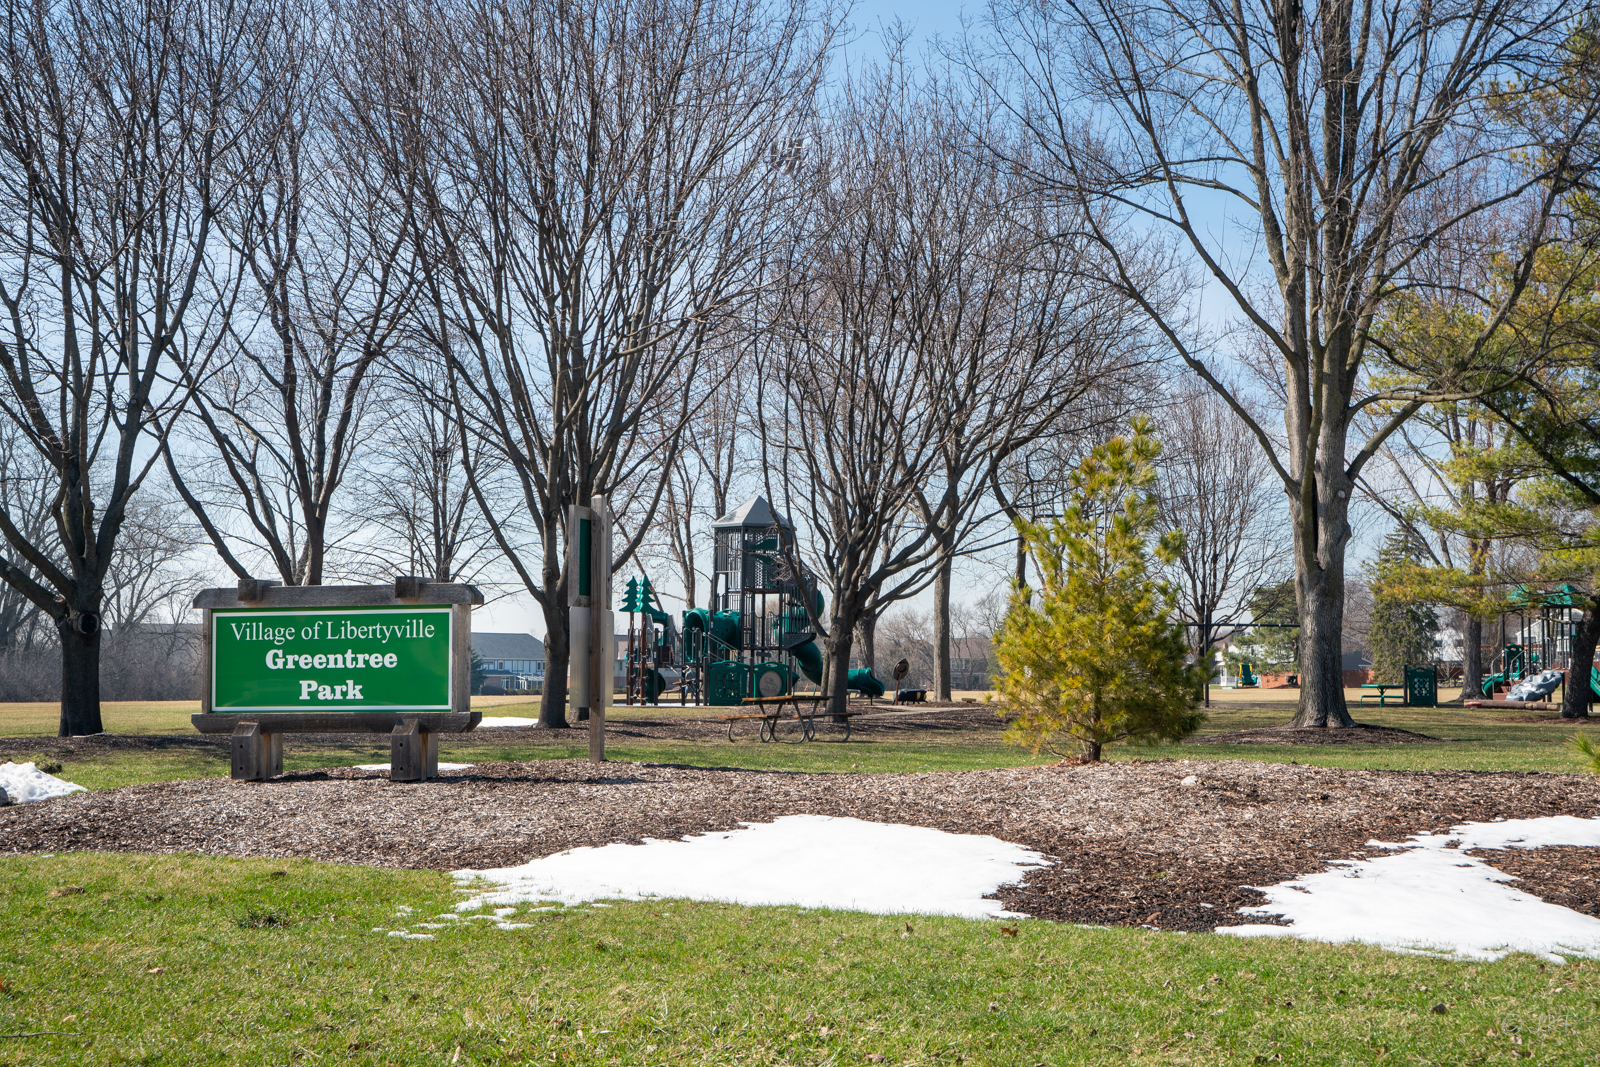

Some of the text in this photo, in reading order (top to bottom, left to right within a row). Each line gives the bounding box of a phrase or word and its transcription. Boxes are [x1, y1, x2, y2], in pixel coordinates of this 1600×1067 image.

[230, 619, 436, 646] Village of Libertyville
[265, 648, 398, 670] Greentree
[299, 680, 364, 700] Park
